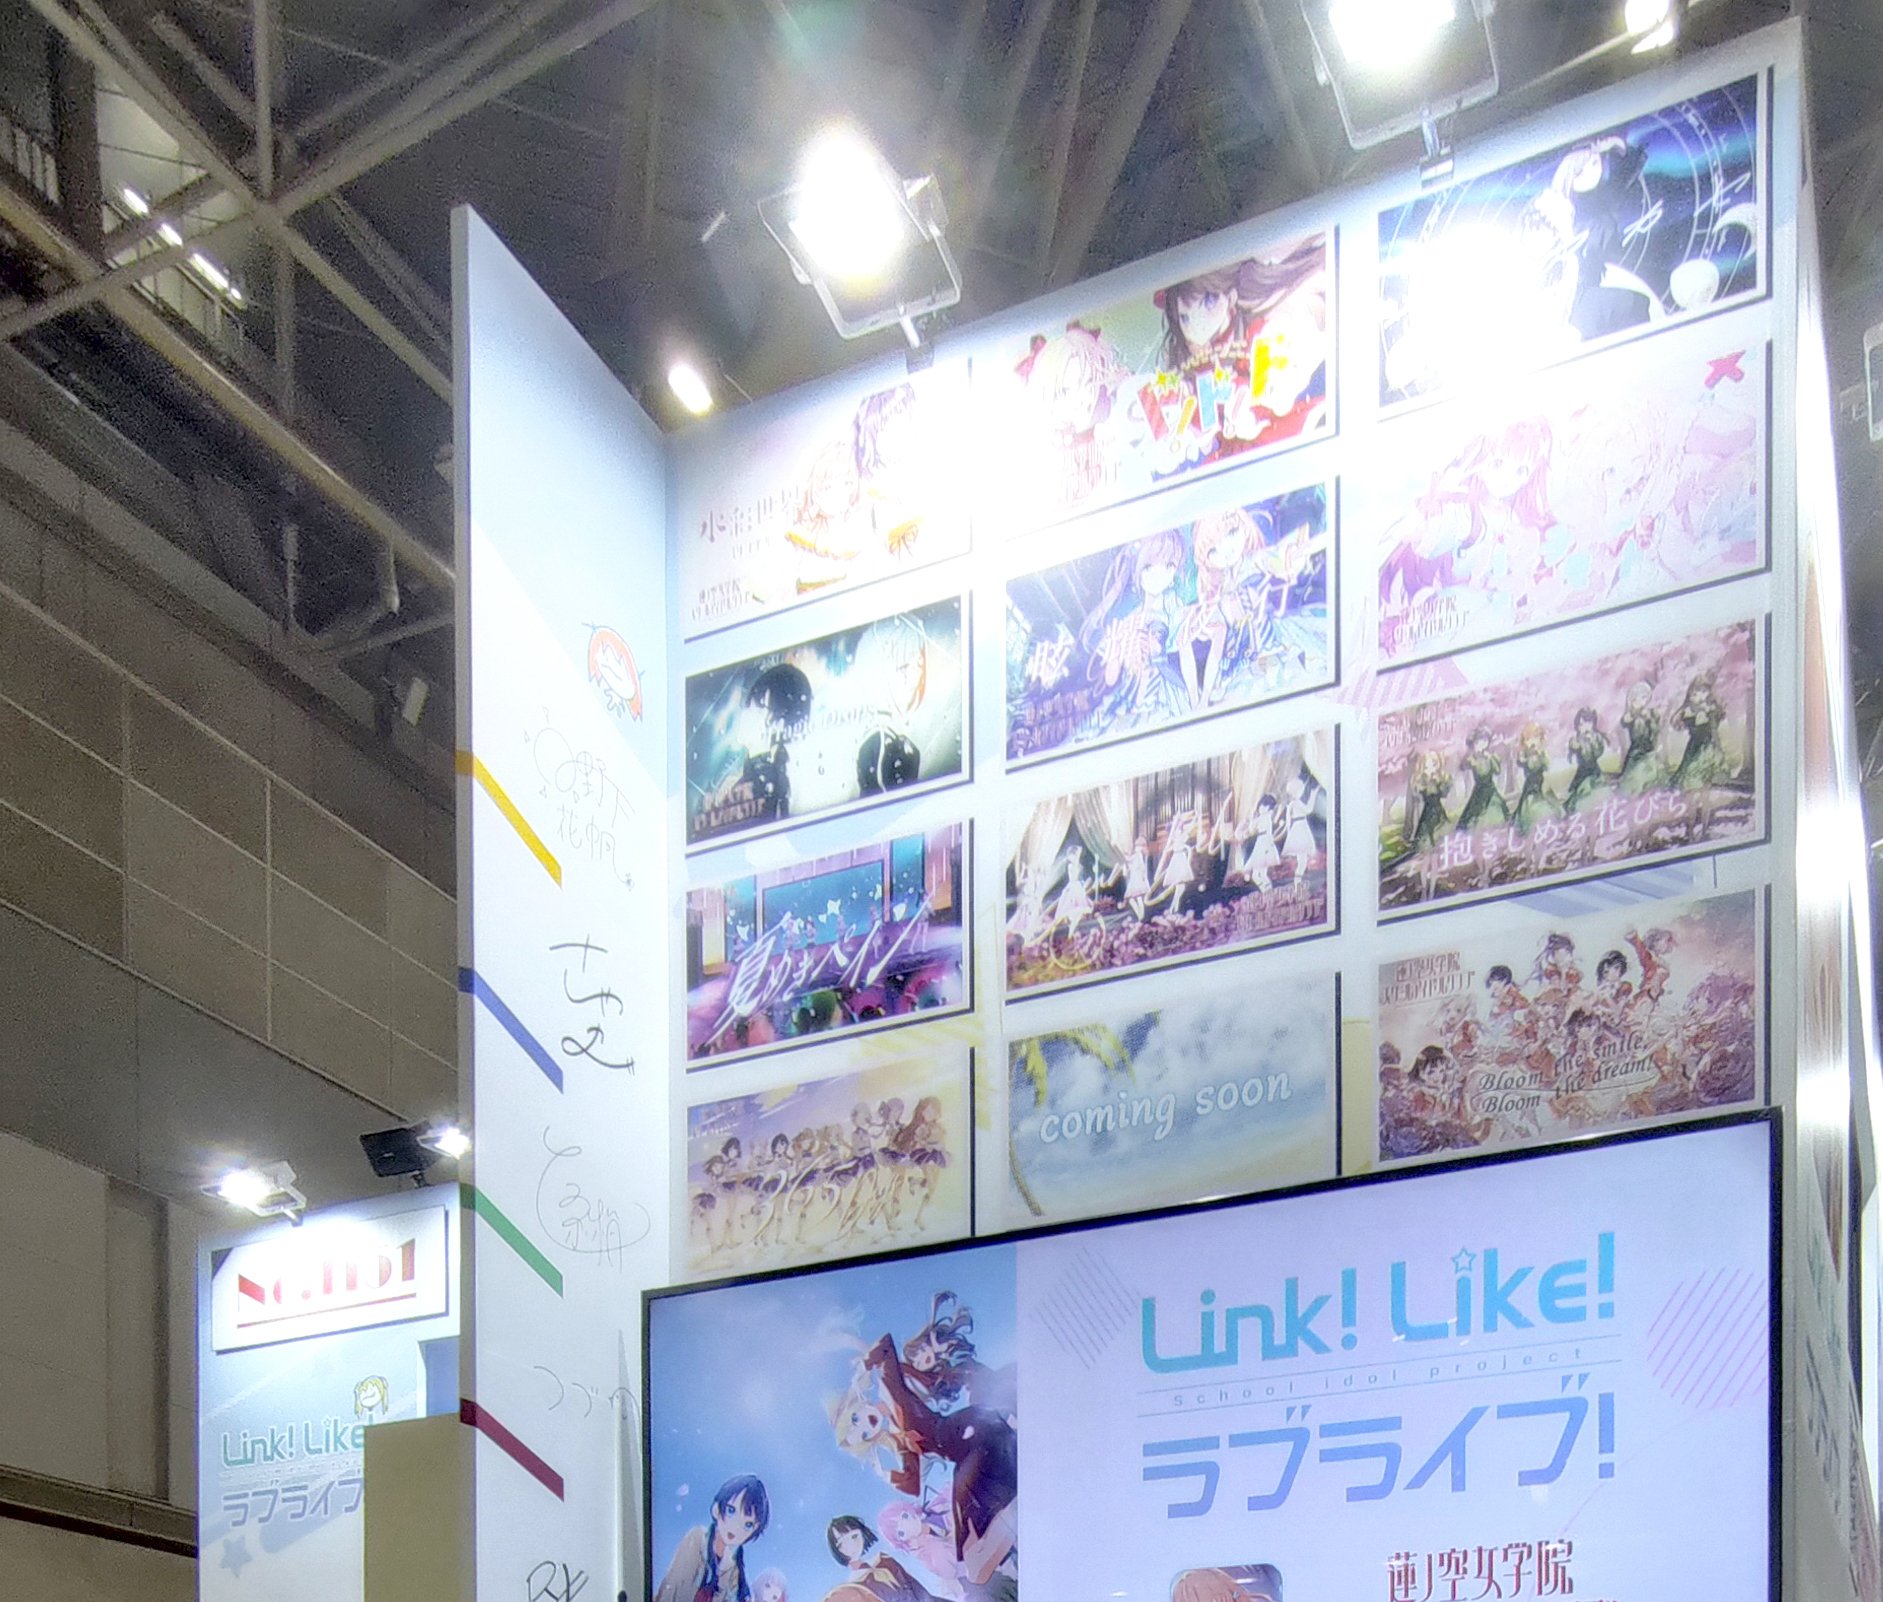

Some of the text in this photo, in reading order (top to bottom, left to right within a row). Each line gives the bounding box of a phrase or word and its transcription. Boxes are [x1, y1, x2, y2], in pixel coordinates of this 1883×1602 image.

[1480, 1070, 1543, 1091] Bloom
[1553, 1051, 1584, 1078] the
[1483, 1093, 1541, 1113] Bloom
[1555, 1073, 1585, 1099] the
[1040, 1070, 1292, 1143] coming soon
[1142, 1231, 1616, 1374] Link! Like!
[1174, 1347, 1583, 1408] School idol project
[223, 1425, 294, 1466] Link!
[1142, 1372, 1616, 1520] ラブライブ!
